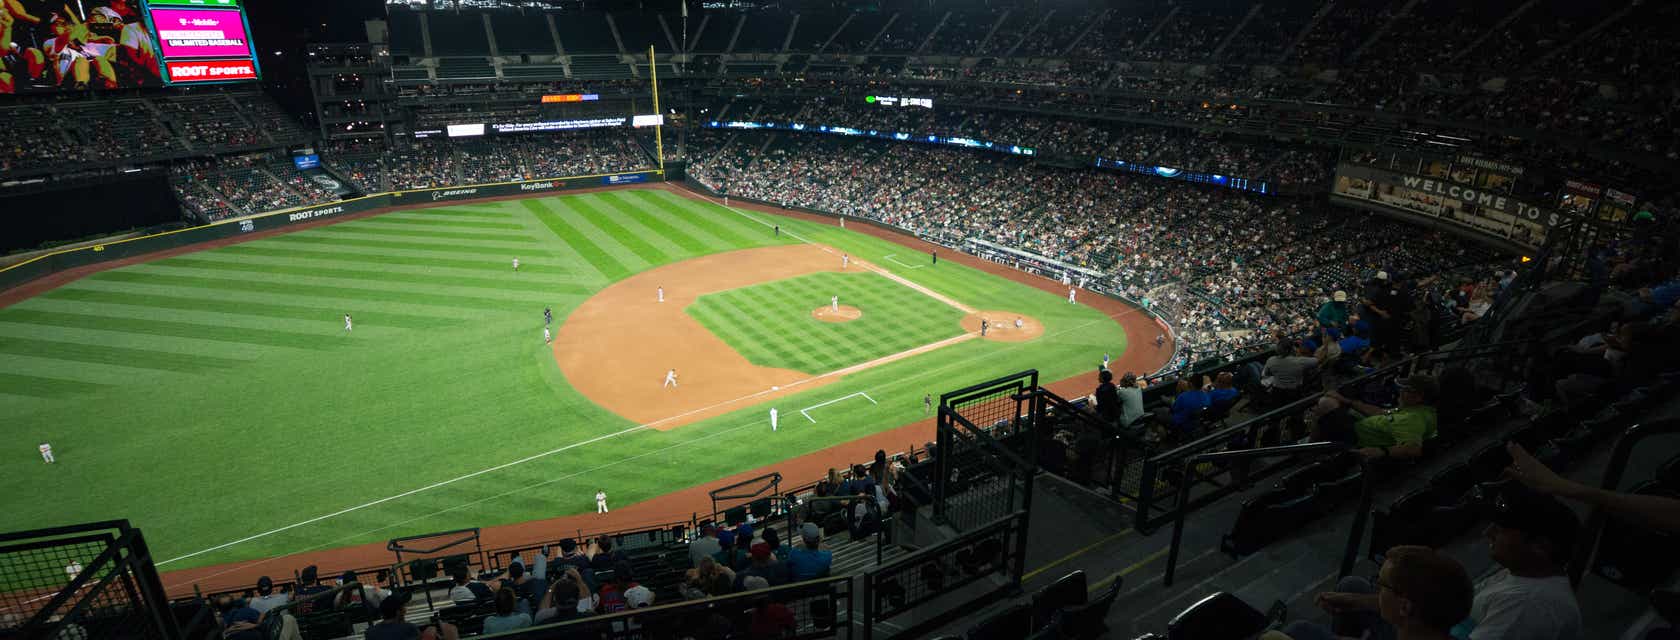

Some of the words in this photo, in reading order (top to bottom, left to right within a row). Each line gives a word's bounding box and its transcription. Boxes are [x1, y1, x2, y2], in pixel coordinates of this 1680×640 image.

[171, 66, 208, 76] ROOT
[521, 182, 553, 191] KeyBank
[443, 188, 477, 196] BOEING
[1403, 176, 1507, 210] WELCOME
[1517, 202, 1540, 220] TO
[289, 210, 313, 222] ROOT
